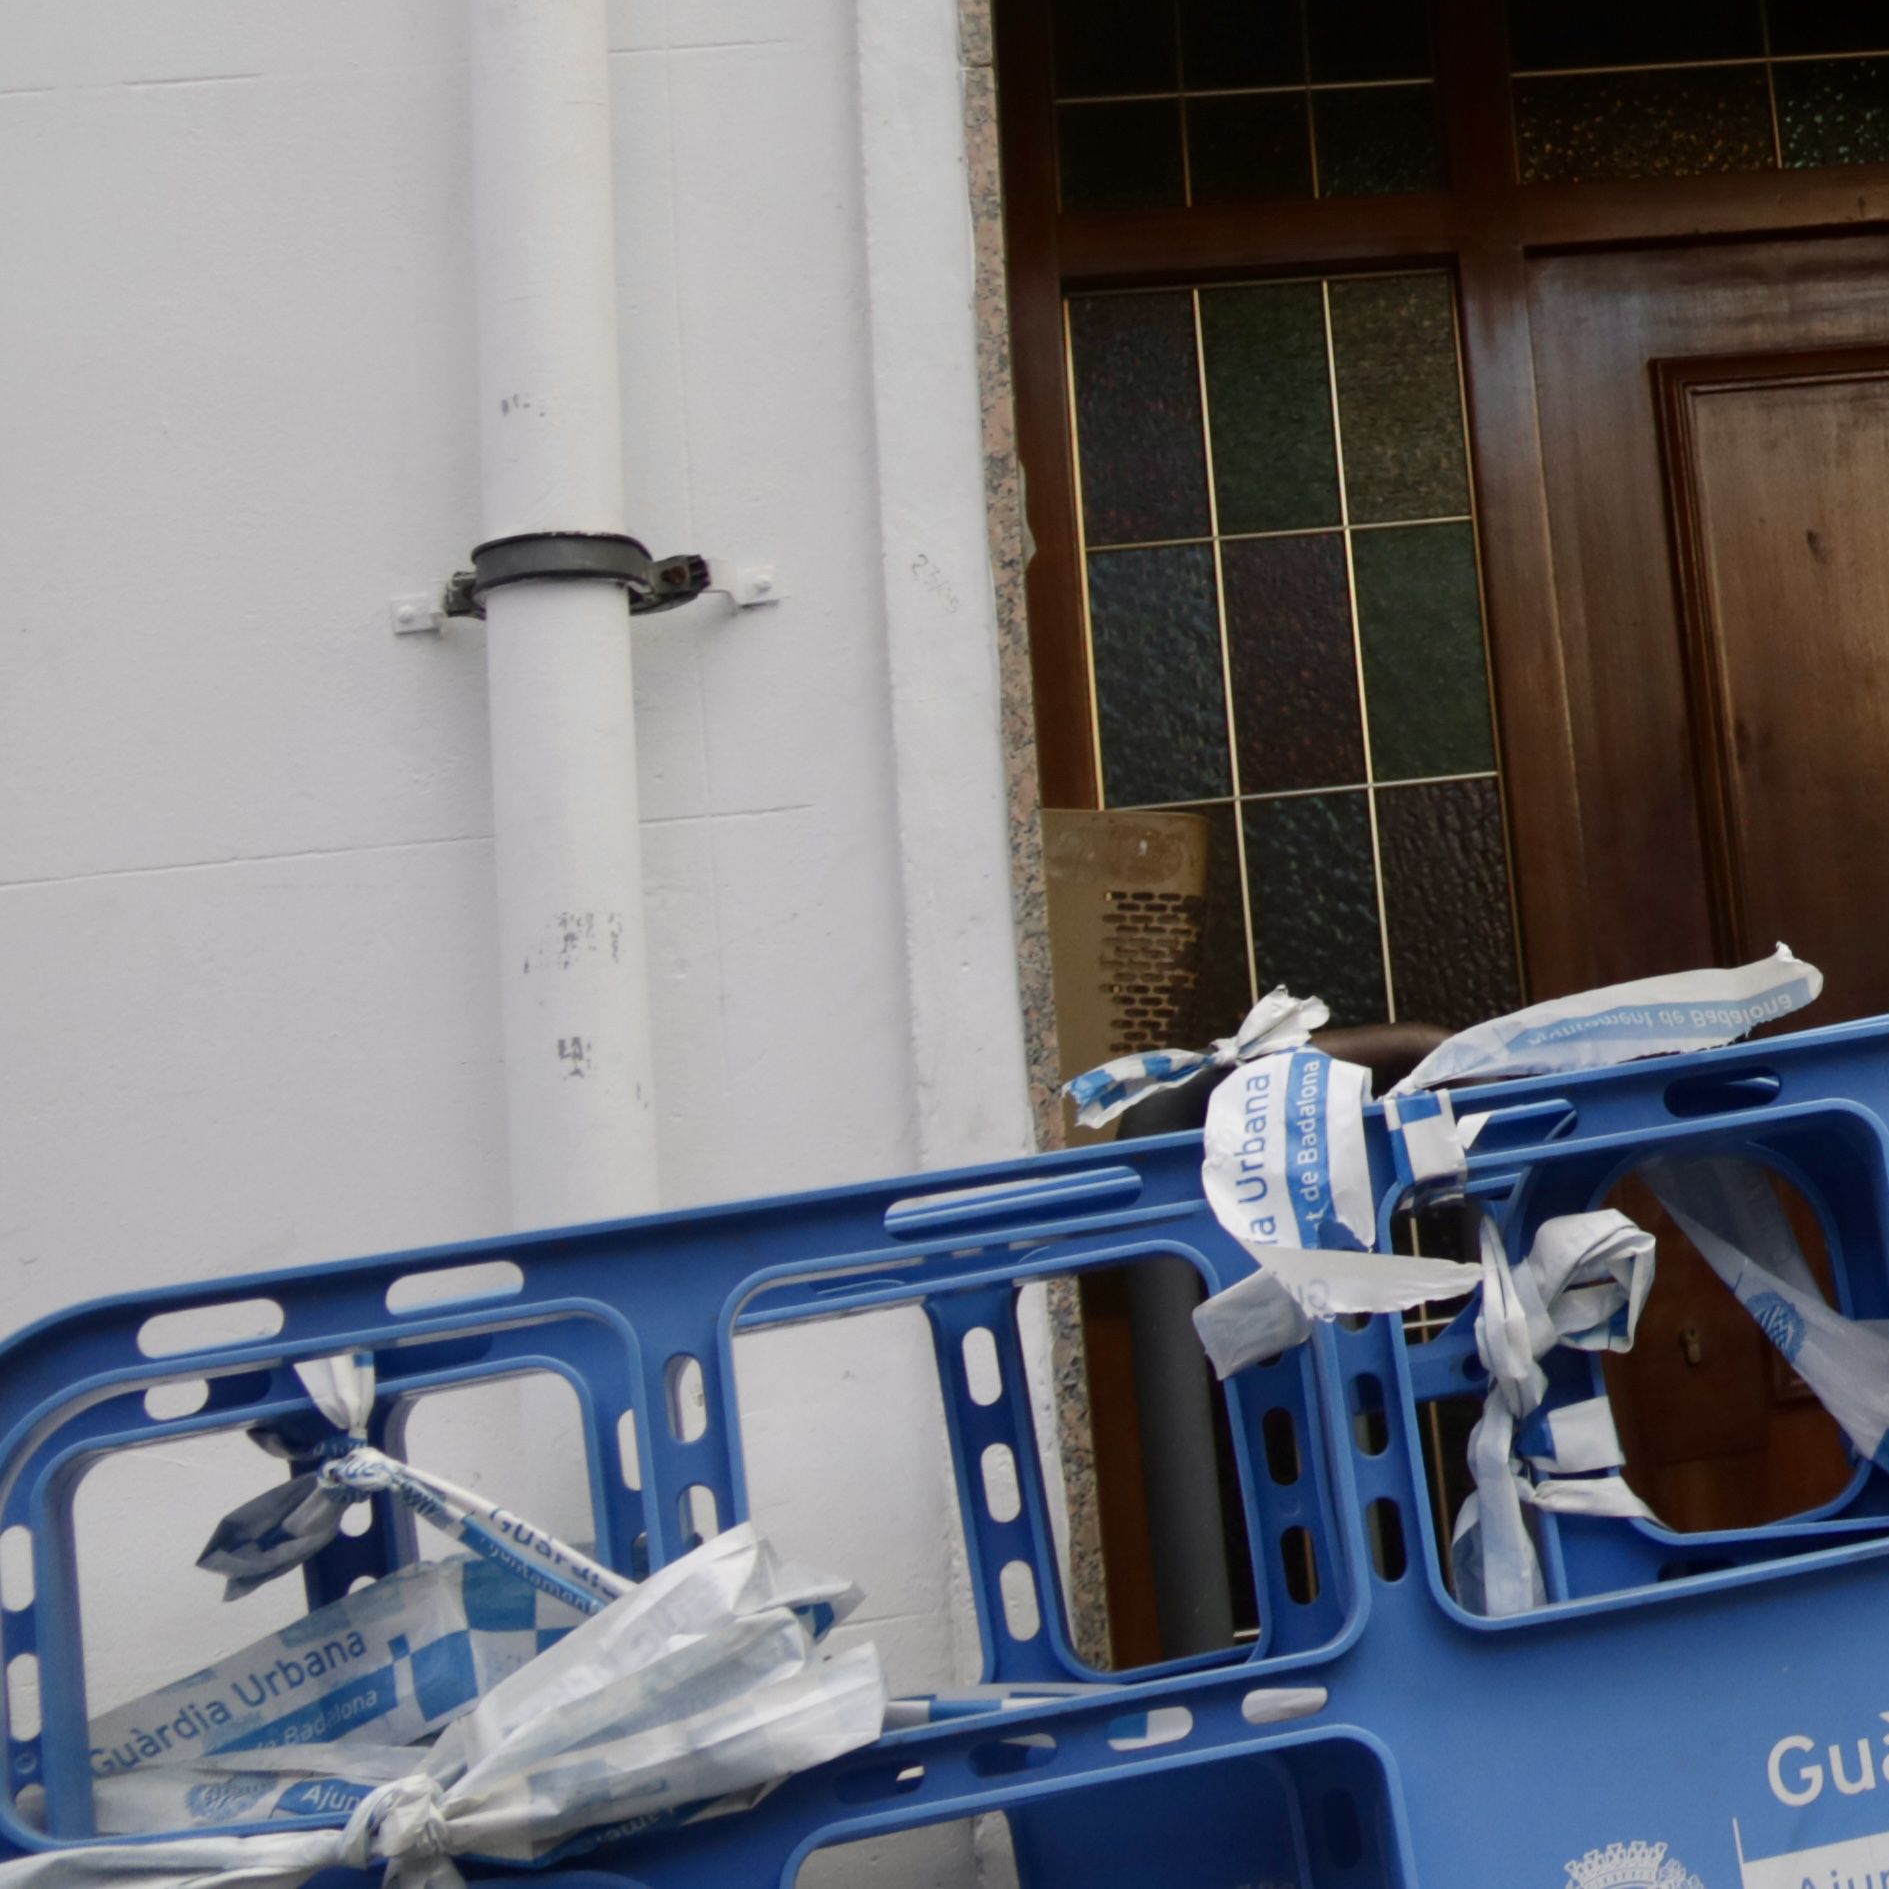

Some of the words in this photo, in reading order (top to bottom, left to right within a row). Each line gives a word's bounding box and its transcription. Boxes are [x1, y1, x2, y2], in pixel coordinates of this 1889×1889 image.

[1233, 1073, 1271, 1206] Urbana
[1296, 1060, 1321, 1166] Badalona
[1300, 1169, 1320, 1202] de
[89, 1698, 233, 1777] Guàrdia
[231, 1630, 369, 1709] Urbana
[284, 1689, 379, 1746] Badalona
